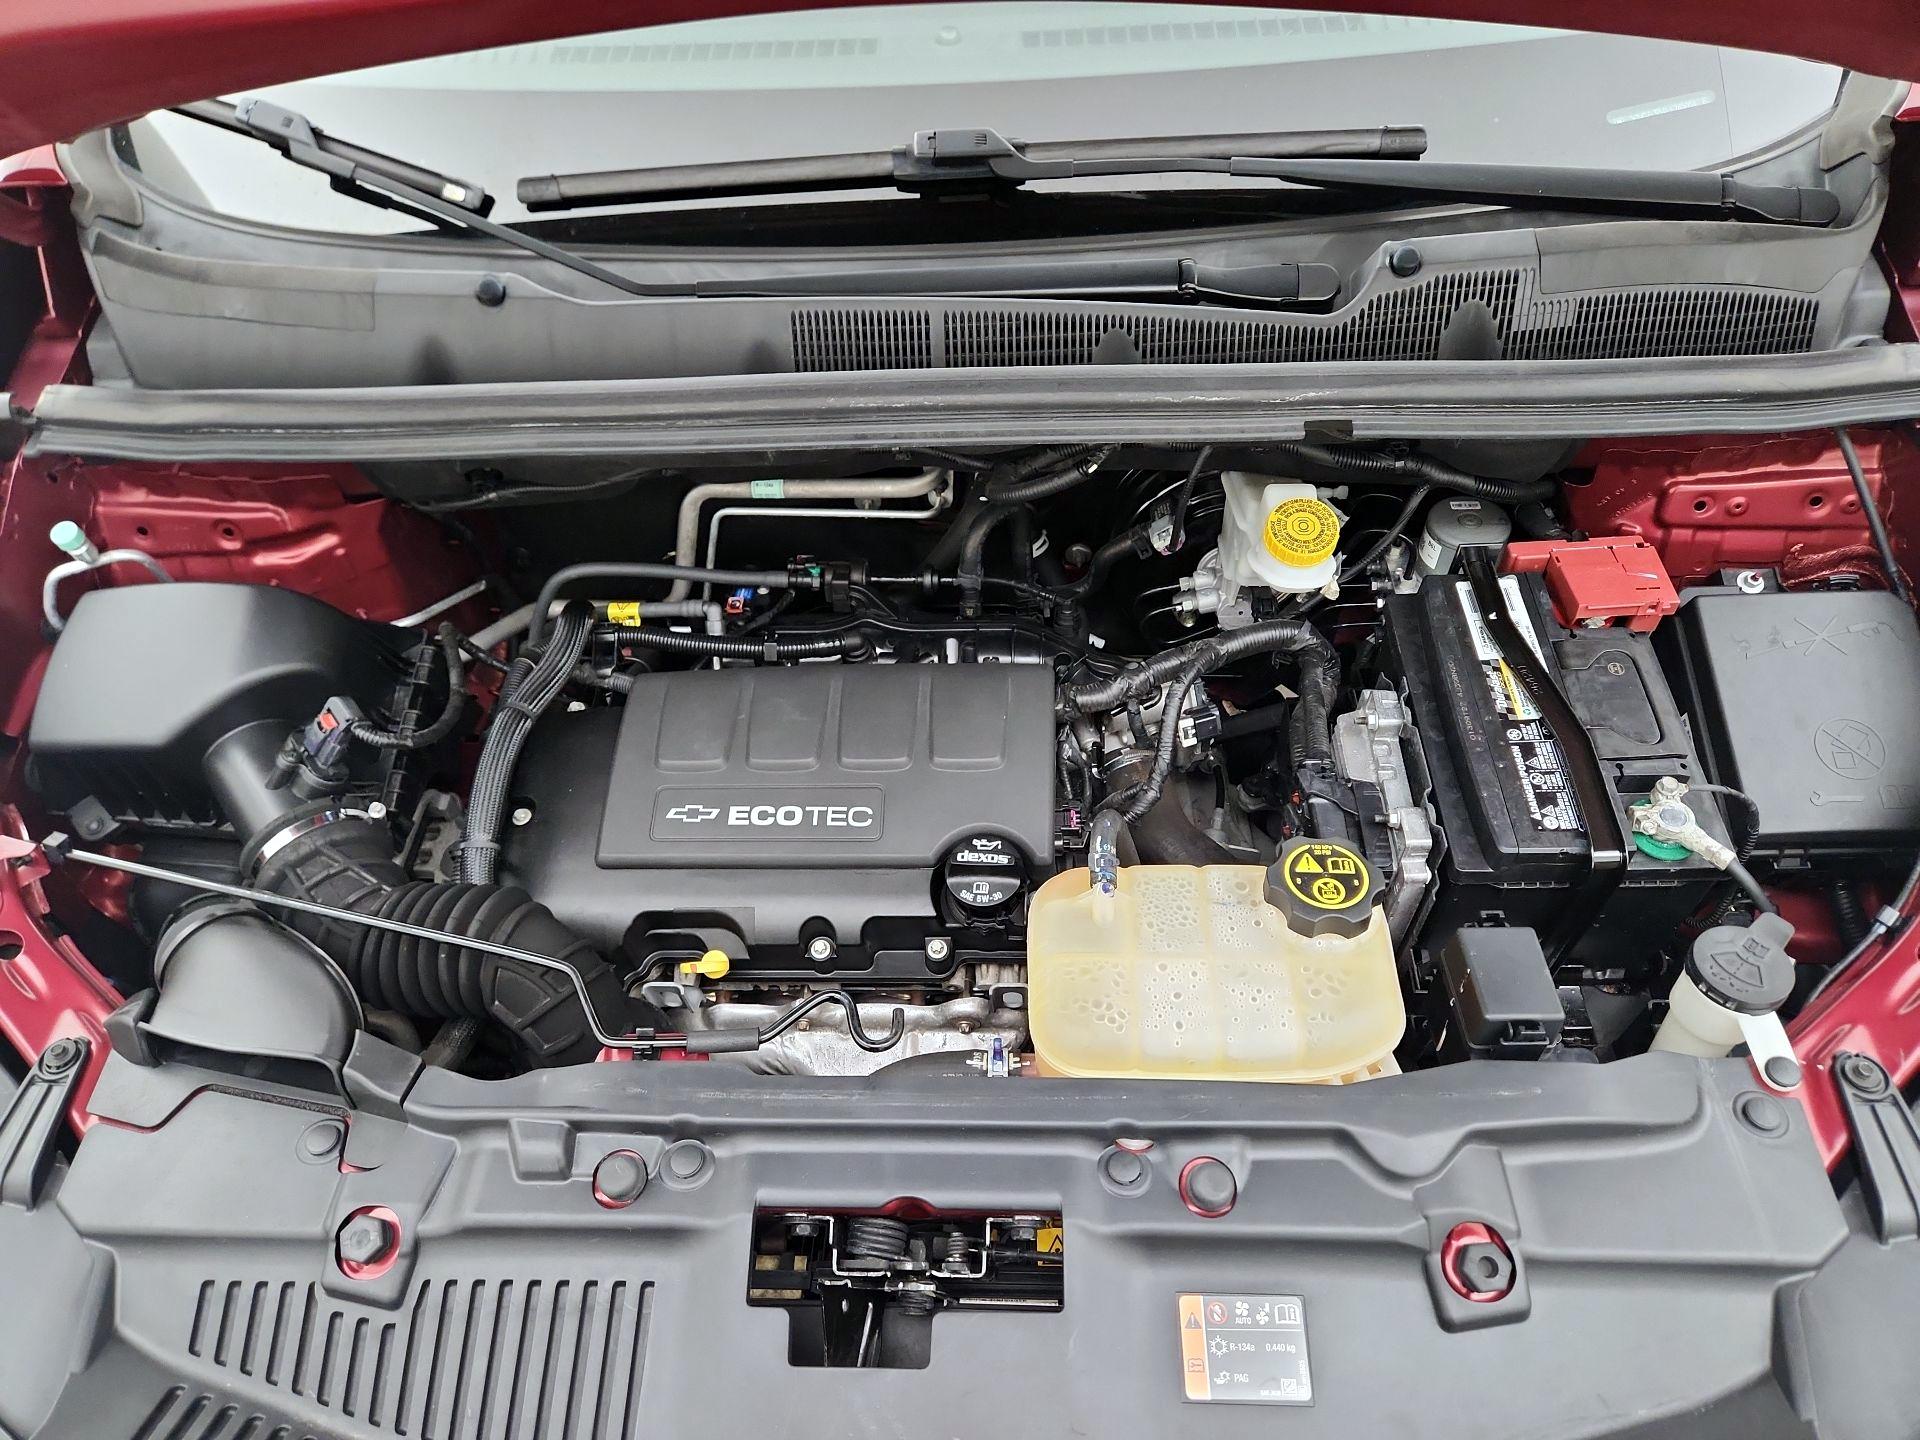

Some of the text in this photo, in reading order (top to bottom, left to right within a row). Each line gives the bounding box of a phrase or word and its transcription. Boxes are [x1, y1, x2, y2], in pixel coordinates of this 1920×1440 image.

[1486, 670, 1510, 709] Duralast
[1510, 745, 1540, 813] DANGER/POISON
[727, 804, 874, 827] ECOTEC
[956, 849, 1010, 864] dexos
[960, 889, 1003, 903] SAE 5W-30
[1235, 1317, 1252, 1325] AUTO
[1229, 1343, 1296, 1354] R-134a 0.440 kg
[1234, 1373, 1249, 1383] PAG
